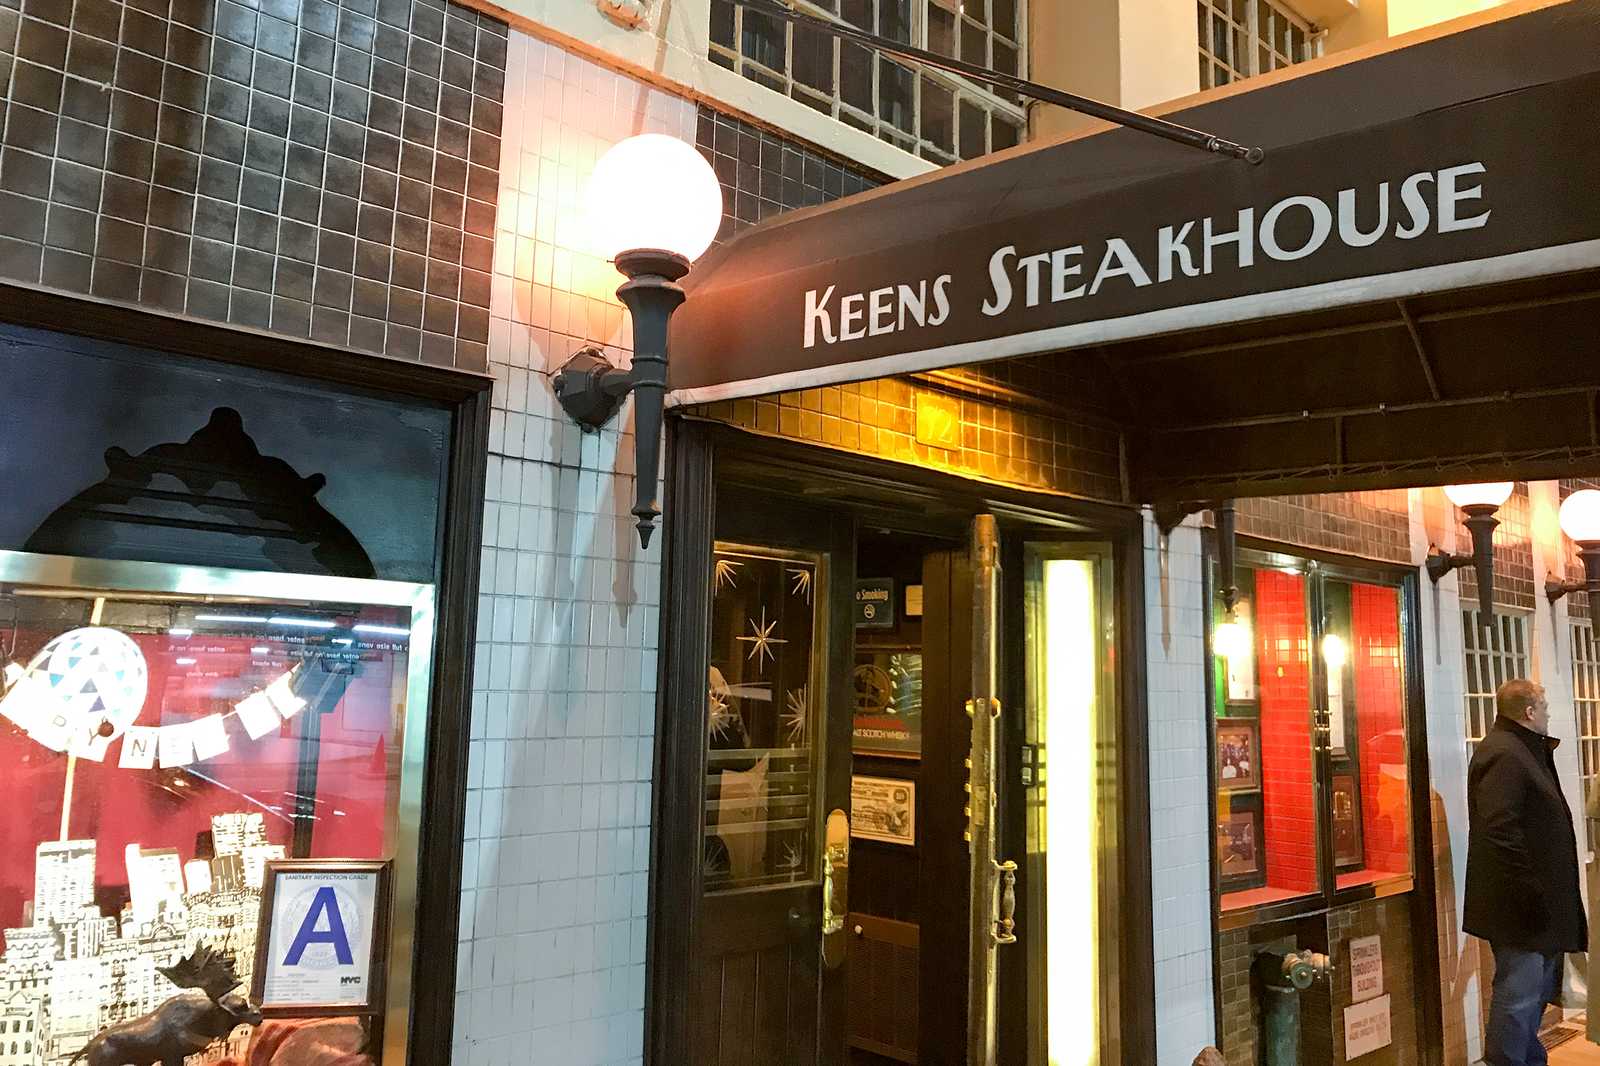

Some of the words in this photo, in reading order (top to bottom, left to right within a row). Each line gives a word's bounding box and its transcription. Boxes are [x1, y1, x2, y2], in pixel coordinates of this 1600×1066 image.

[803, 274, 951, 348] KEENS
[981, 161, 1492, 317] STEAKHOUSE
[861, 588, 889, 601] Smoking
[282, 887, 354, 965] A
[340, 976, 361, 985] NYC
